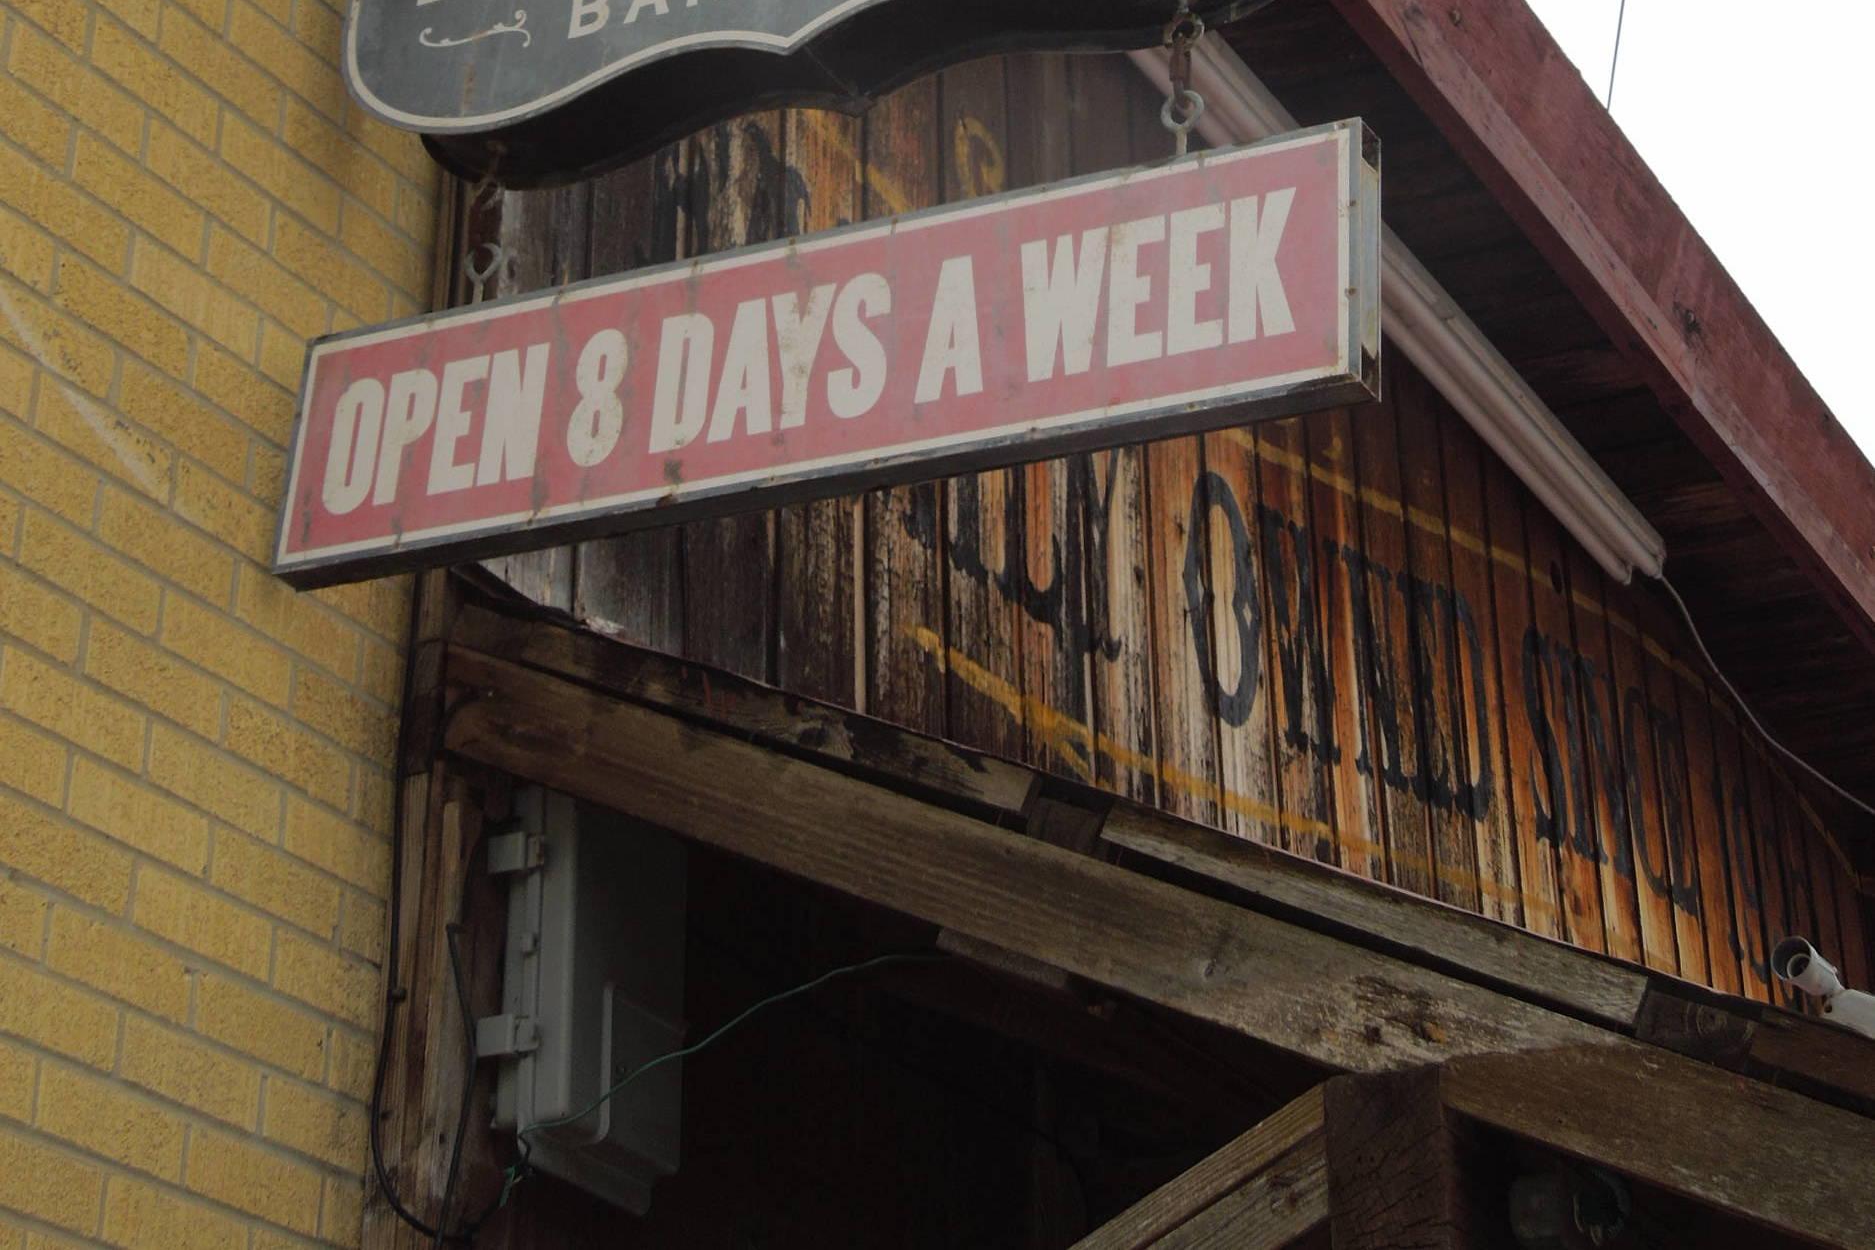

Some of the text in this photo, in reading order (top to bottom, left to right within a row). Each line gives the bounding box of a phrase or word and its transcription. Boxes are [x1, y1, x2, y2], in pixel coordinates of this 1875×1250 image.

[321, 186, 1298, 516] OPEN 8 DAYS A WEEK
